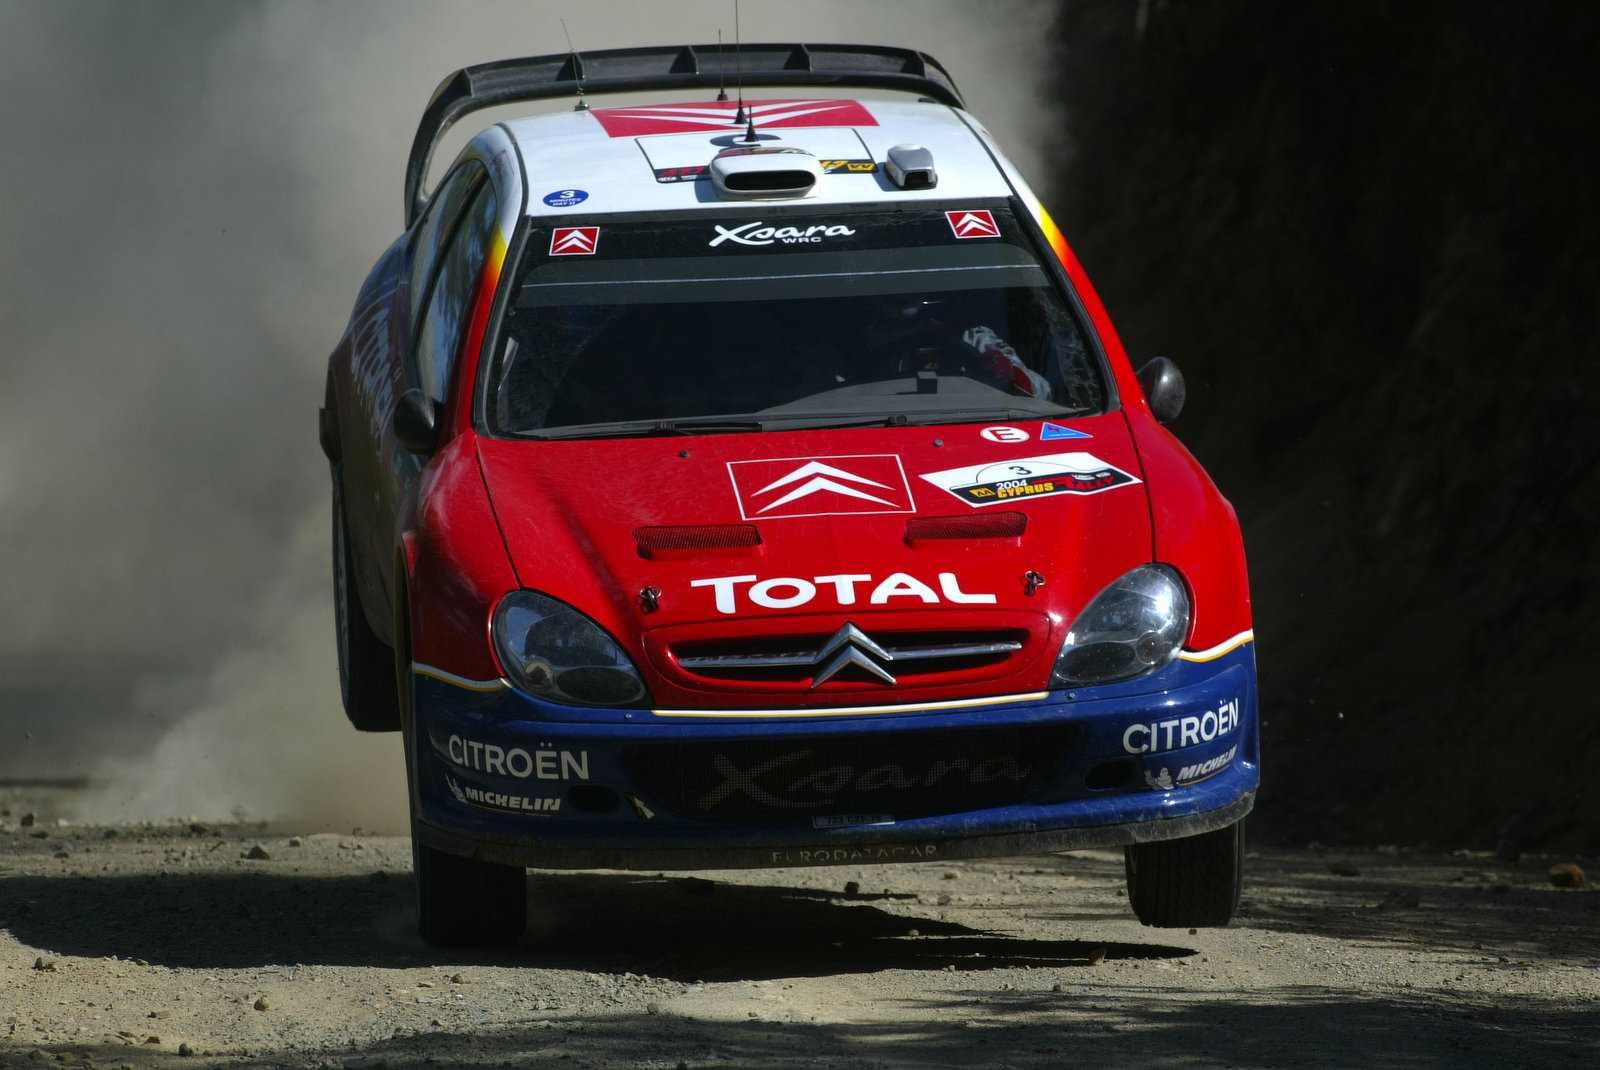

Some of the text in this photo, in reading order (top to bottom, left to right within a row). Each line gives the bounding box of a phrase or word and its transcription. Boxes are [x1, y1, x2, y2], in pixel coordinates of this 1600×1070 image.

[560, 190, 576, 198] 3
[708, 221, 856, 247] Xsara
[988, 428, 1022, 441] E
[1008, 465, 1032, 476] 3
[976, 489, 993, 498] AA
[997, 482, 1054, 499] CYPRUS
[1032, 473, 1115, 490] RALLY
[996, 479, 1028, 490] 2004
[690, 572, 997, 614] TOTAL
[1122, 698, 1239, 754] CITROËN
[448, 734, 590, 780] CITROËN
[1176, 744, 1238, 781] MICHELIN
[696, 750, 1034, 812] Xsara
[464, 786, 562, 811] MICHELIN
